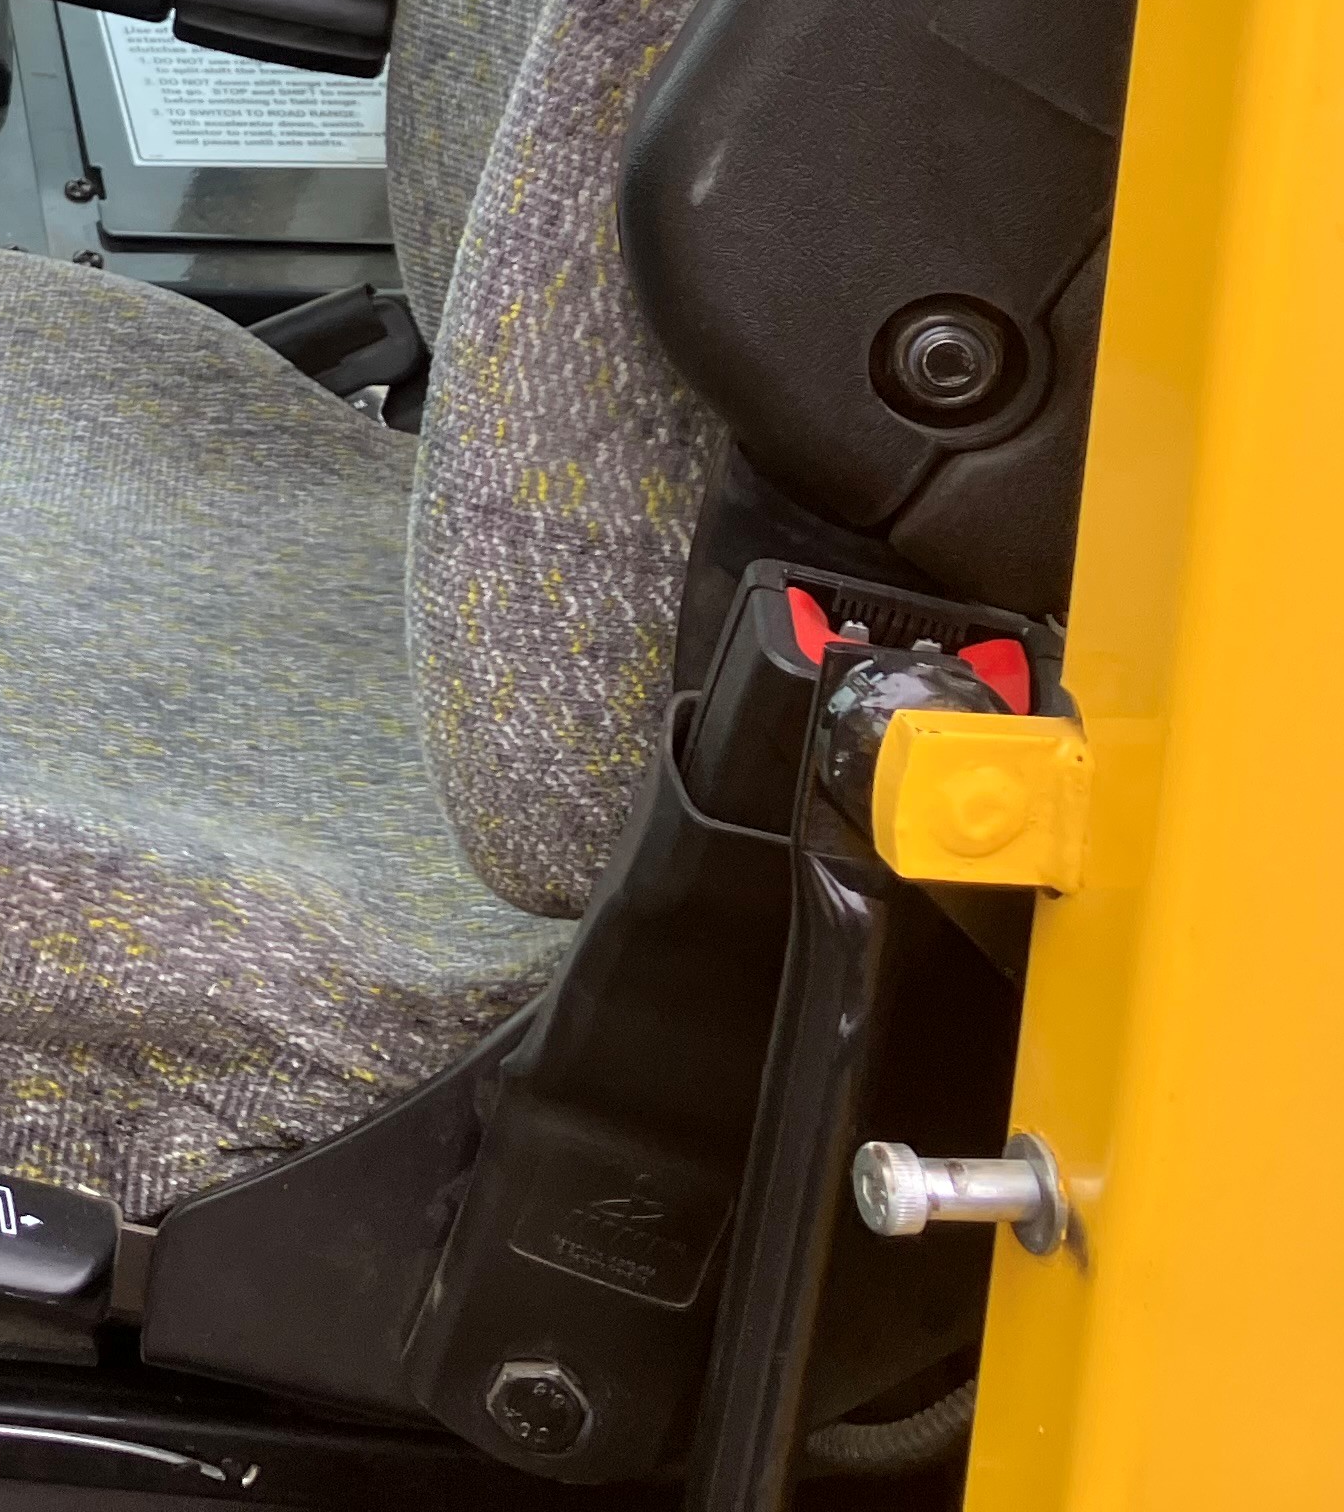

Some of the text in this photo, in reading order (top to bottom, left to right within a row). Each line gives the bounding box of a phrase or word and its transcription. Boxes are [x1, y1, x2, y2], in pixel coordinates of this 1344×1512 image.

[153, 57, 174, 65] DO
[176, 57, 204, 65] NOT
[159, 78, 179, 86] DO
[182, 78, 210, 86] NOT
[212, 88, 248, 96] STOP
[166, 108, 186, 117] TO
[189, 108, 242, 117] SWITCH
[247, 108, 265, 117] TO
[266, 108, 306, 117] ROAD
